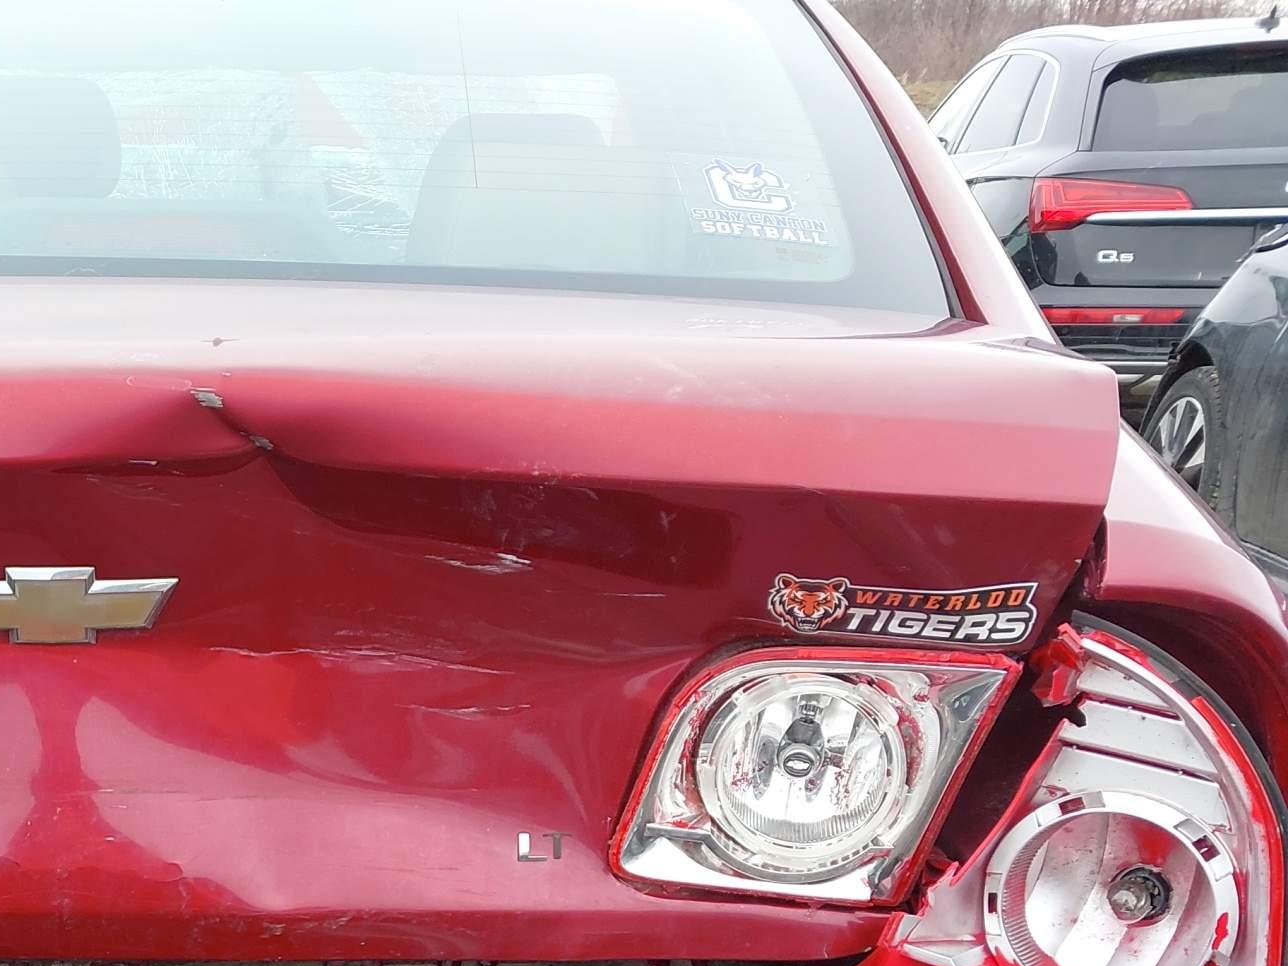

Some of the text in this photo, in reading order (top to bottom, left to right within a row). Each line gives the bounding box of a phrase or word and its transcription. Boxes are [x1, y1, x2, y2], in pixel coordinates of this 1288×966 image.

[701, 220, 828, 246] SOFTBALL
[855, 589, 1027, 611] WATERLOO
[846, 608, 1030, 641] TIGERS
[517, 831, 573, 862] LT
